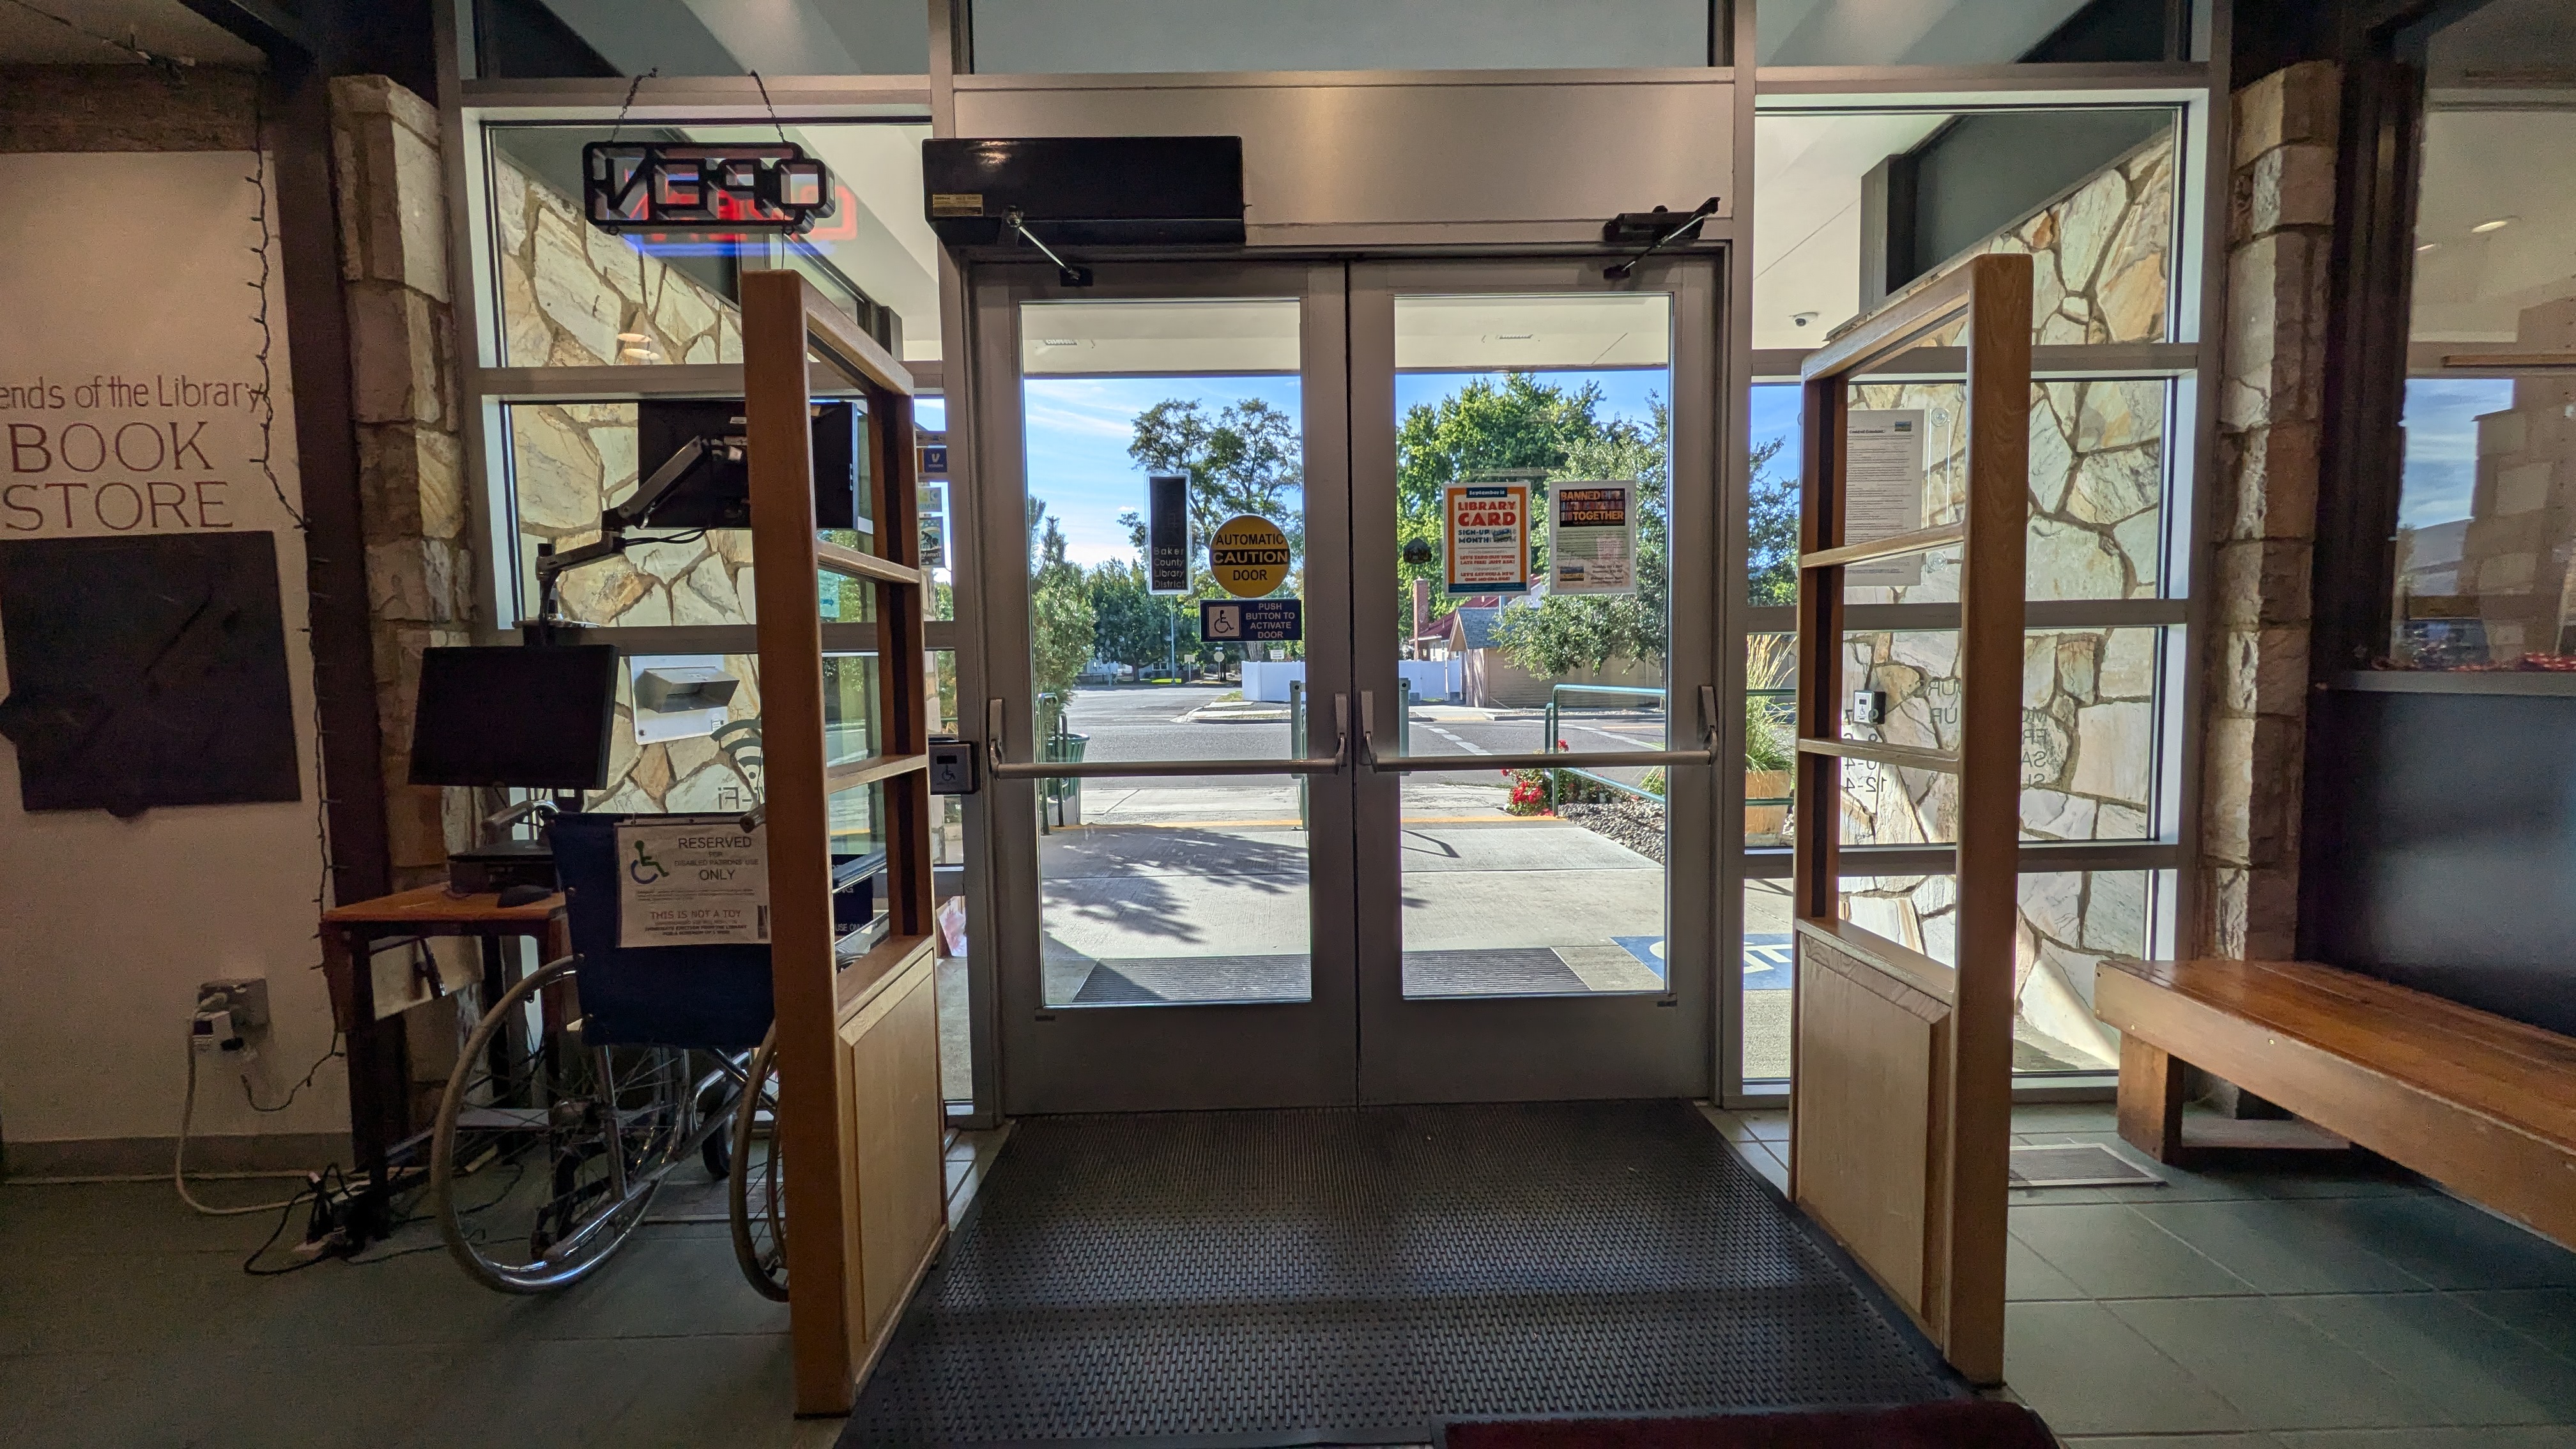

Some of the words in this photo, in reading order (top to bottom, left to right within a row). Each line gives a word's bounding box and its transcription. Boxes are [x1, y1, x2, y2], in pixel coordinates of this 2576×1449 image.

[75, 375, 102, 408] of
[107, 375, 149, 408] the
[157, 374, 261, 413] Library
[8, 421, 214, 473] BOOK
[1560, 491, 1601, 501] BANNED
[3, 481, 233, 531] STORE
[1457, 502, 1516, 511] LIBRARY
[1458, 512, 1517, 526] CARD
[1572, 510, 1624, 521] TOGETHER
[1216, 533, 1284, 546] AUTOMATIC
[1154, 547, 1184, 555] Baker
[1154, 558, 1184, 567] County
[1213, 551, 1288, 564] CAUTION
[1154, 569, 1184, 578] Library
[1233, 569, 1268, 581] DOOR
[1154, 579, 1185, 588] District
[1258, 602, 1282, 611] PUSH
[1246, 612, 1281, 620] BUTTON
[1282, 611, 1295, 620] TO
[1250, 621, 1292, 630] ACTIVATE
[1257, 631, 1284, 639] DOOR
[678, 836, 752, 849] RESERVED
[699, 869, 735, 880] ONLY
[650, 911, 674, 919] THIS
[677, 910, 687, 919] IS
[691, 910, 710, 918] NOT
[713, 910, 719, 918] A
[723, 909, 741, 917] TOY
